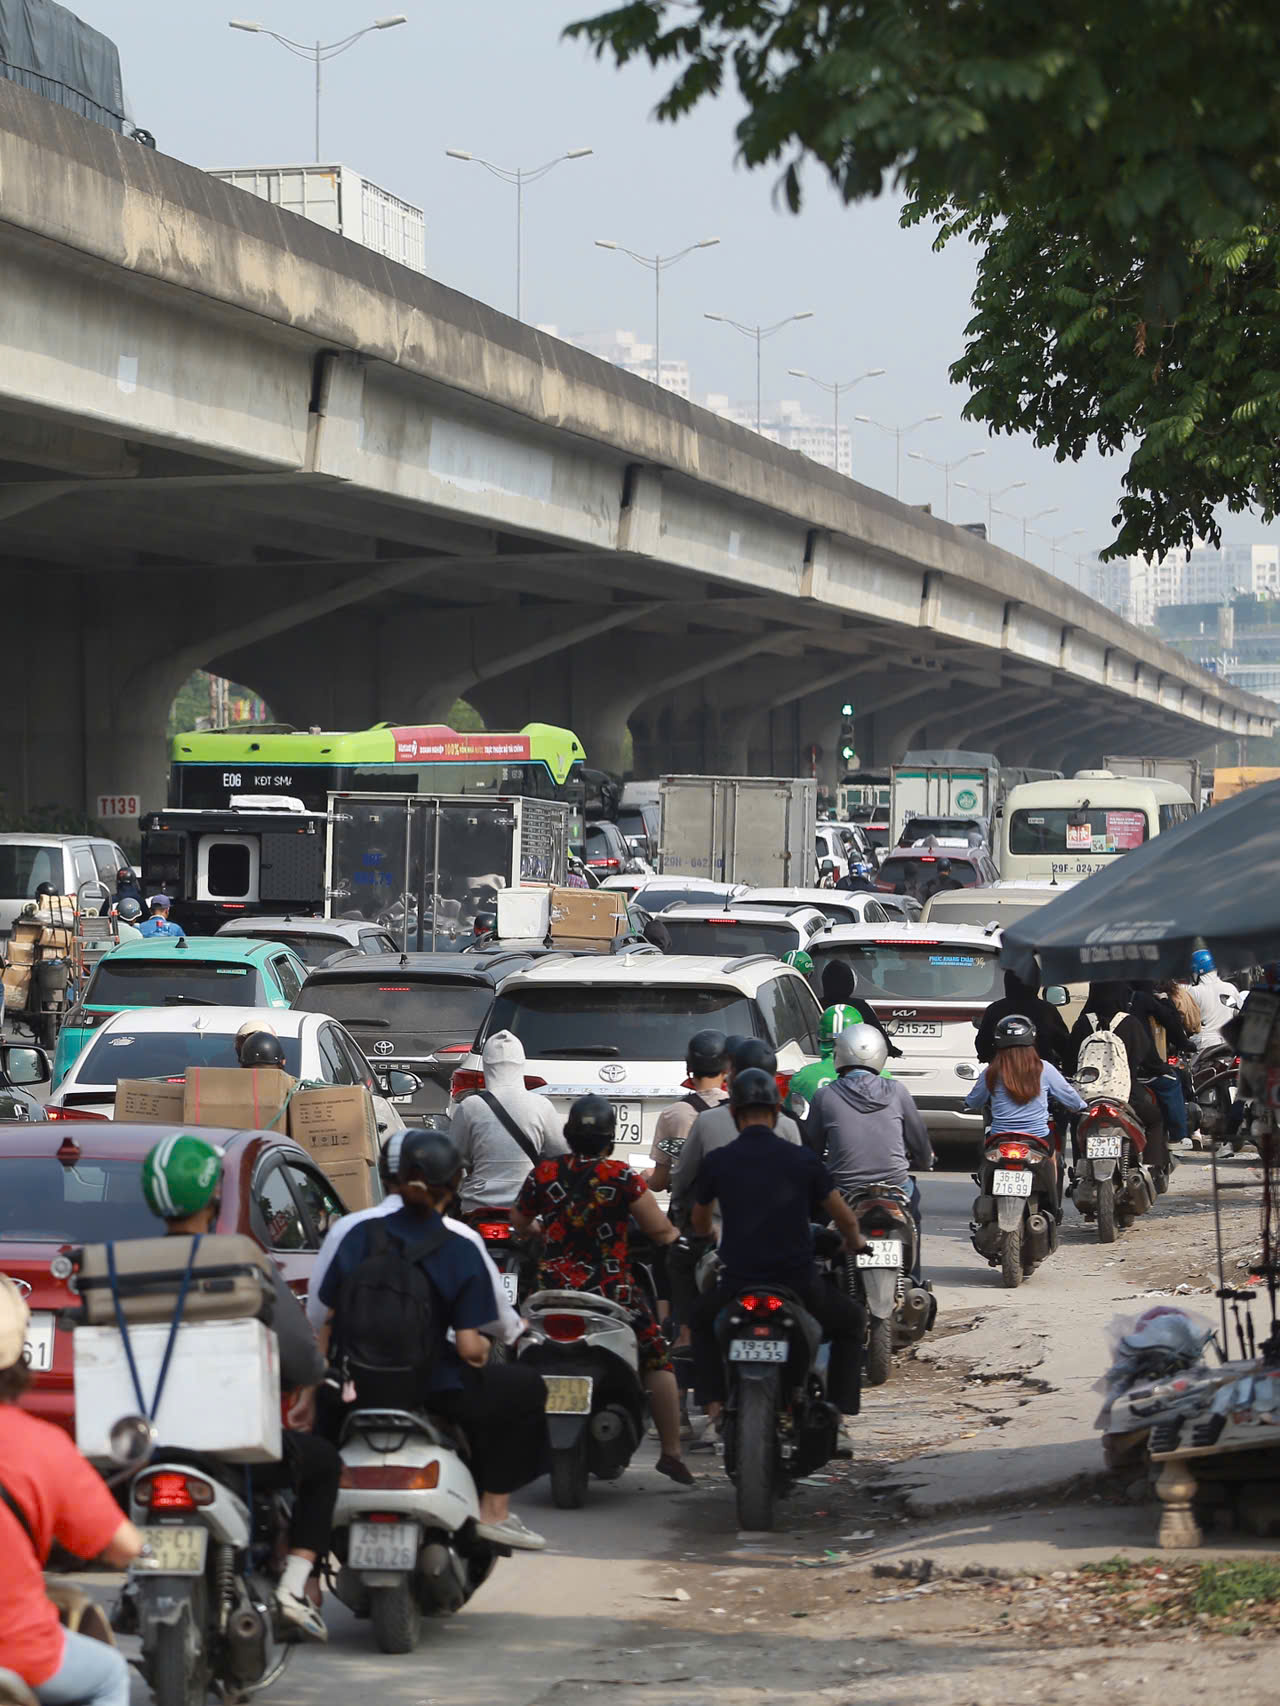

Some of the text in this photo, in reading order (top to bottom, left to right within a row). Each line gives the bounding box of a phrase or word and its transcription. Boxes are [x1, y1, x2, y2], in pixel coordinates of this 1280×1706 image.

[445, 743, 459, 756] 100%
[223, 772, 242, 787] E06
[100, 797, 137, 816] T139
[1053, 864, 1069, 873] 29F
[892, 1009, 917, 1017] KIA
[1089, 1147, 1120, 1157] 323.40
[995, 1183, 1029, 1195] 716.99
[859, 1254, 899, 1266] 522.89
